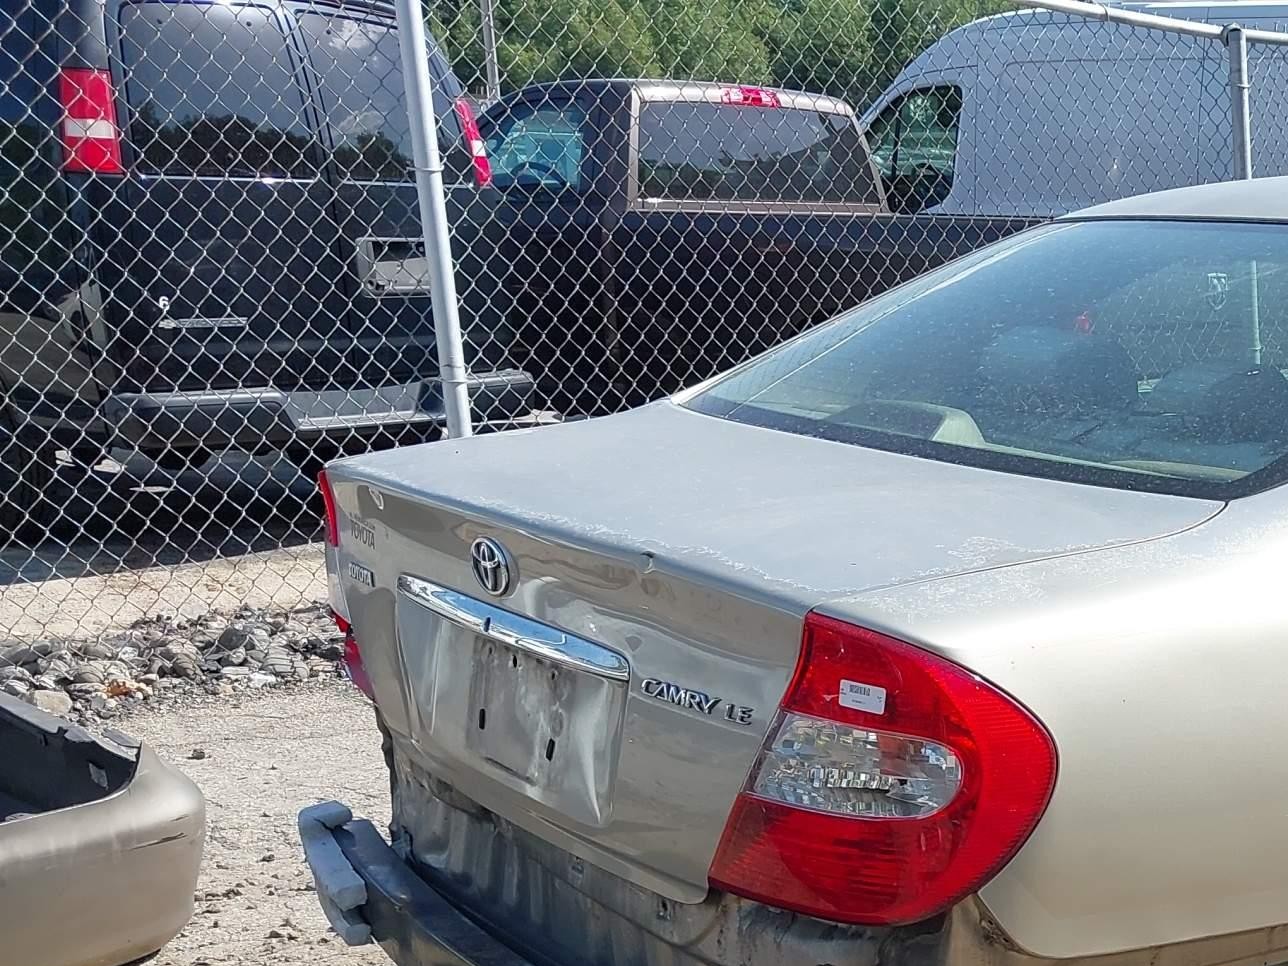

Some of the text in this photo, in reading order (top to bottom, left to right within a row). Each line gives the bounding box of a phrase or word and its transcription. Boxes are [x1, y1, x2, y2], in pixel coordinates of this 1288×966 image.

[349, 519, 376, 550] TOYOTA
[348, 562, 376, 587] TOYOTA
[641, 677, 755, 726] CAMRY LE
